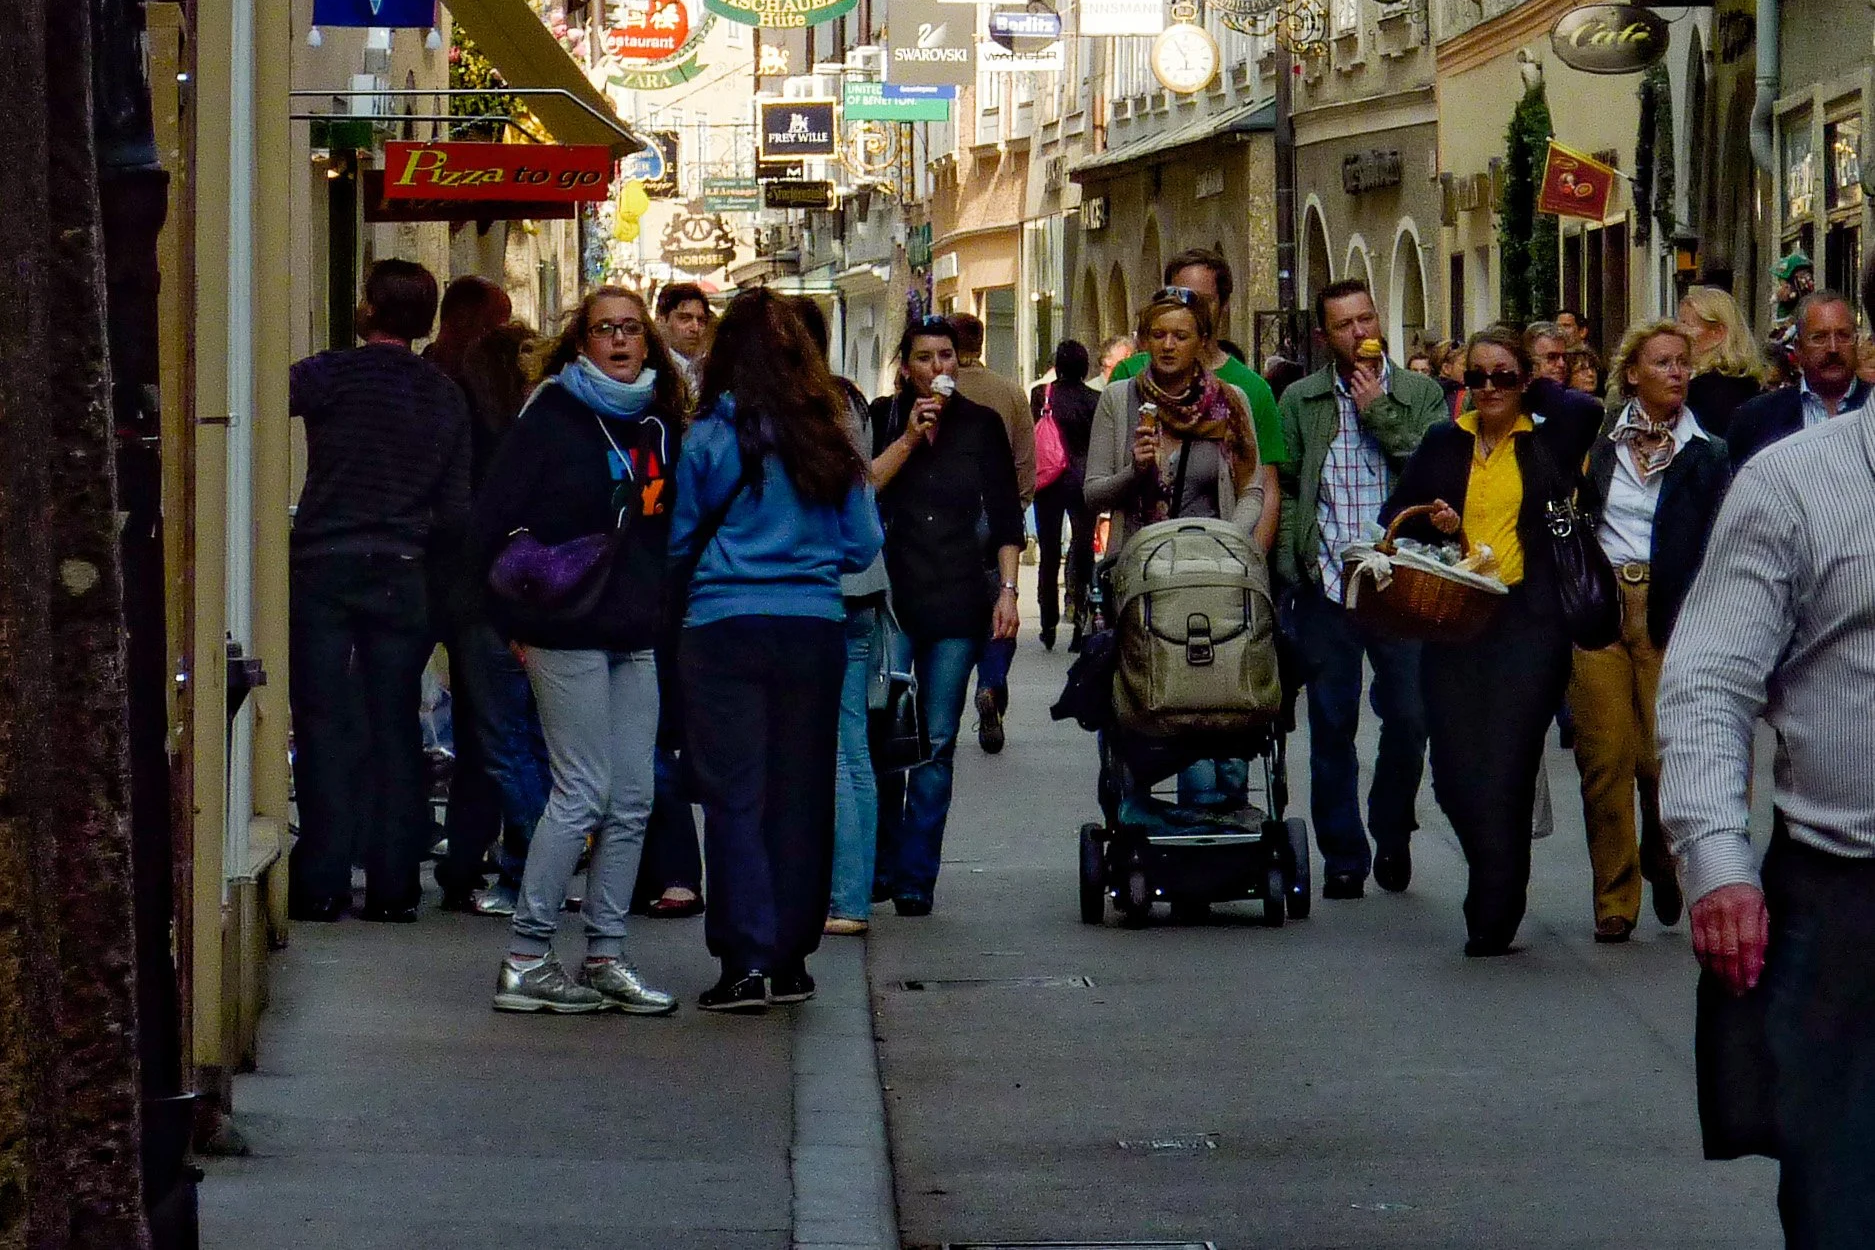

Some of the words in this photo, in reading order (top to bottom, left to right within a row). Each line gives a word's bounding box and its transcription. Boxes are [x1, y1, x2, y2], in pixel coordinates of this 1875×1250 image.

[757, 12, 807, 29] Hüte
[995, 16, 1055, 32] Berlitz
[607, 34, 675, 50] estaurant
[894, 48, 968, 62] SWAROVSKI
[847, 95, 860, 106] OF
[768, 132, 797, 144] FREY
[797, 131, 829, 143] WILLE
[392, 149, 506, 188] Pizza
[514, 165, 551, 185] to
[553, 169, 602, 190] go
[673, 253, 725, 266] NORDSEE
